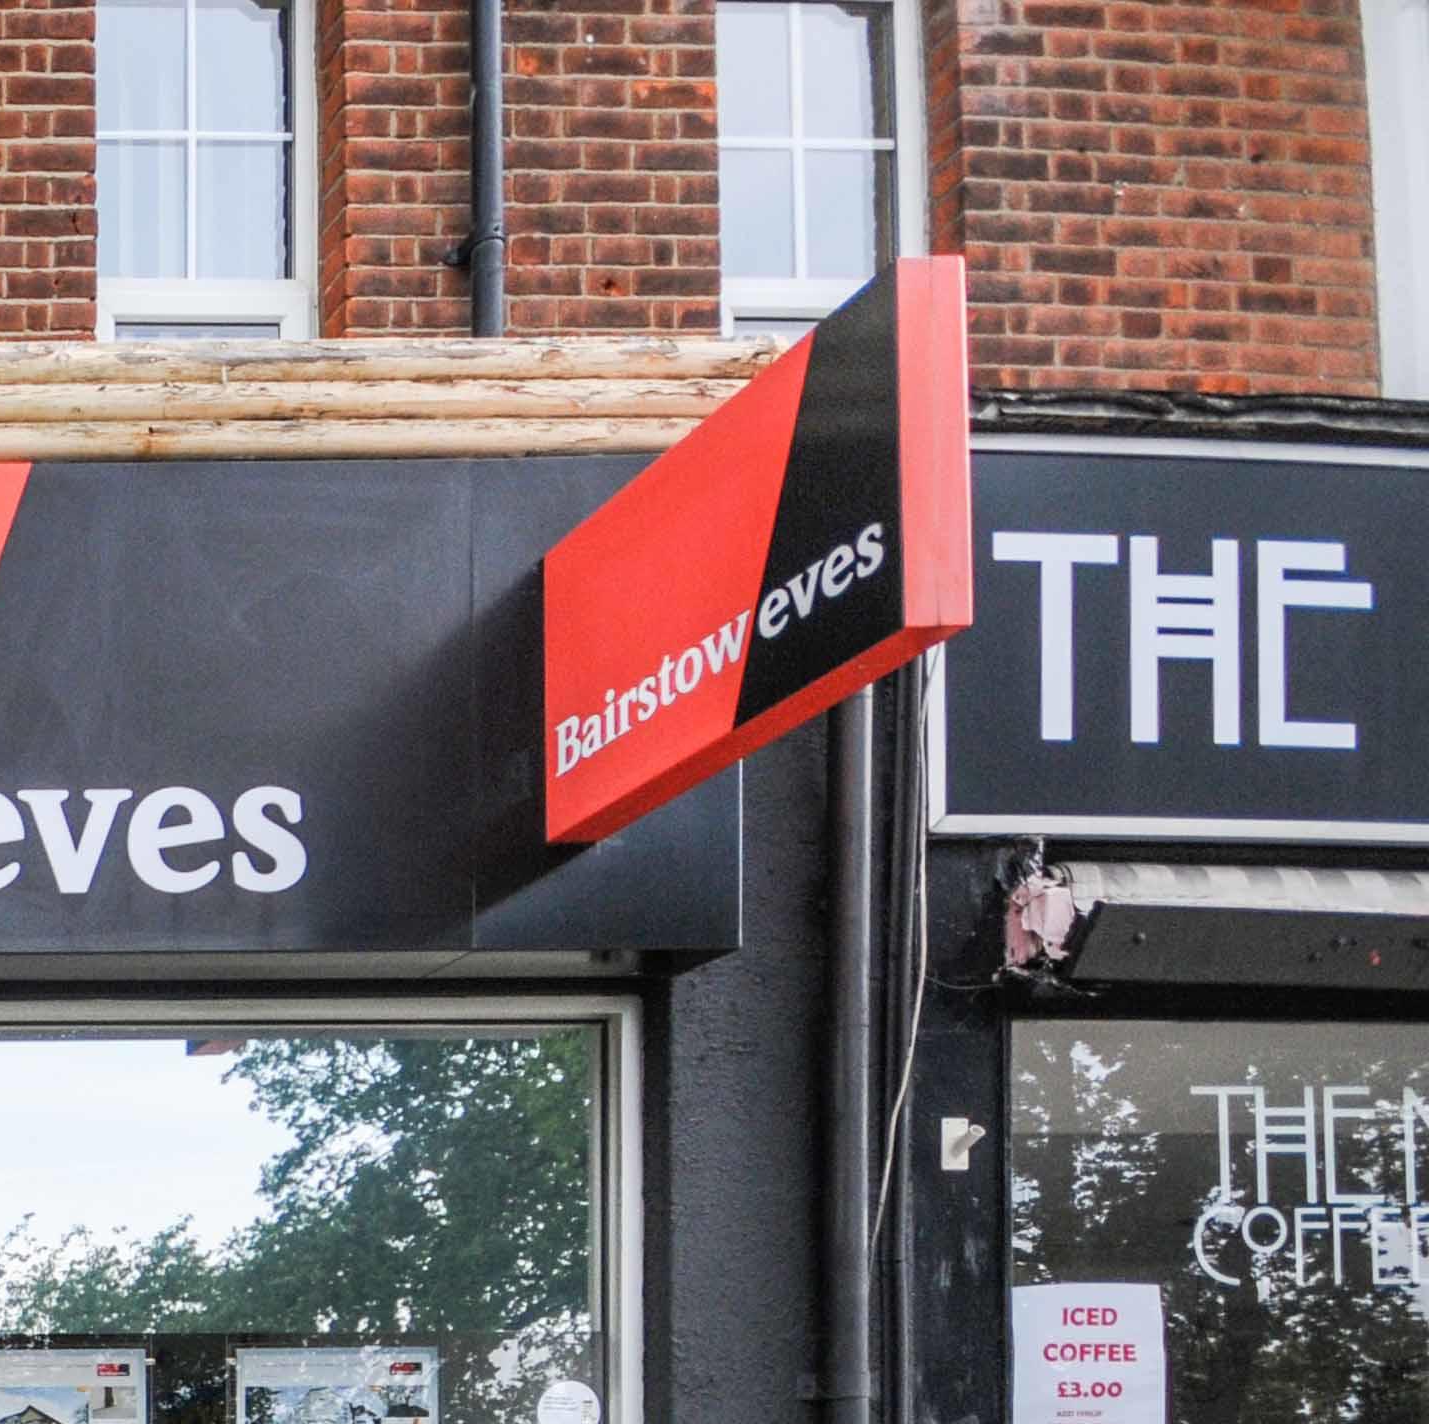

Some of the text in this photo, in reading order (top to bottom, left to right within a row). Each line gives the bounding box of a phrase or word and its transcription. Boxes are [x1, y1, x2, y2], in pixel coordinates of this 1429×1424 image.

[554, 521, 885, 777] Bairstow eves
[992, 531, 1372, 749] THE
[1190, 1085, 1385, 1204] THE
[1062, 1307, 1118, 1326] ICED
[1043, 1343, 1138, 1362] COFFEE
[1057, 1381, 1123, 1398] £3.00
